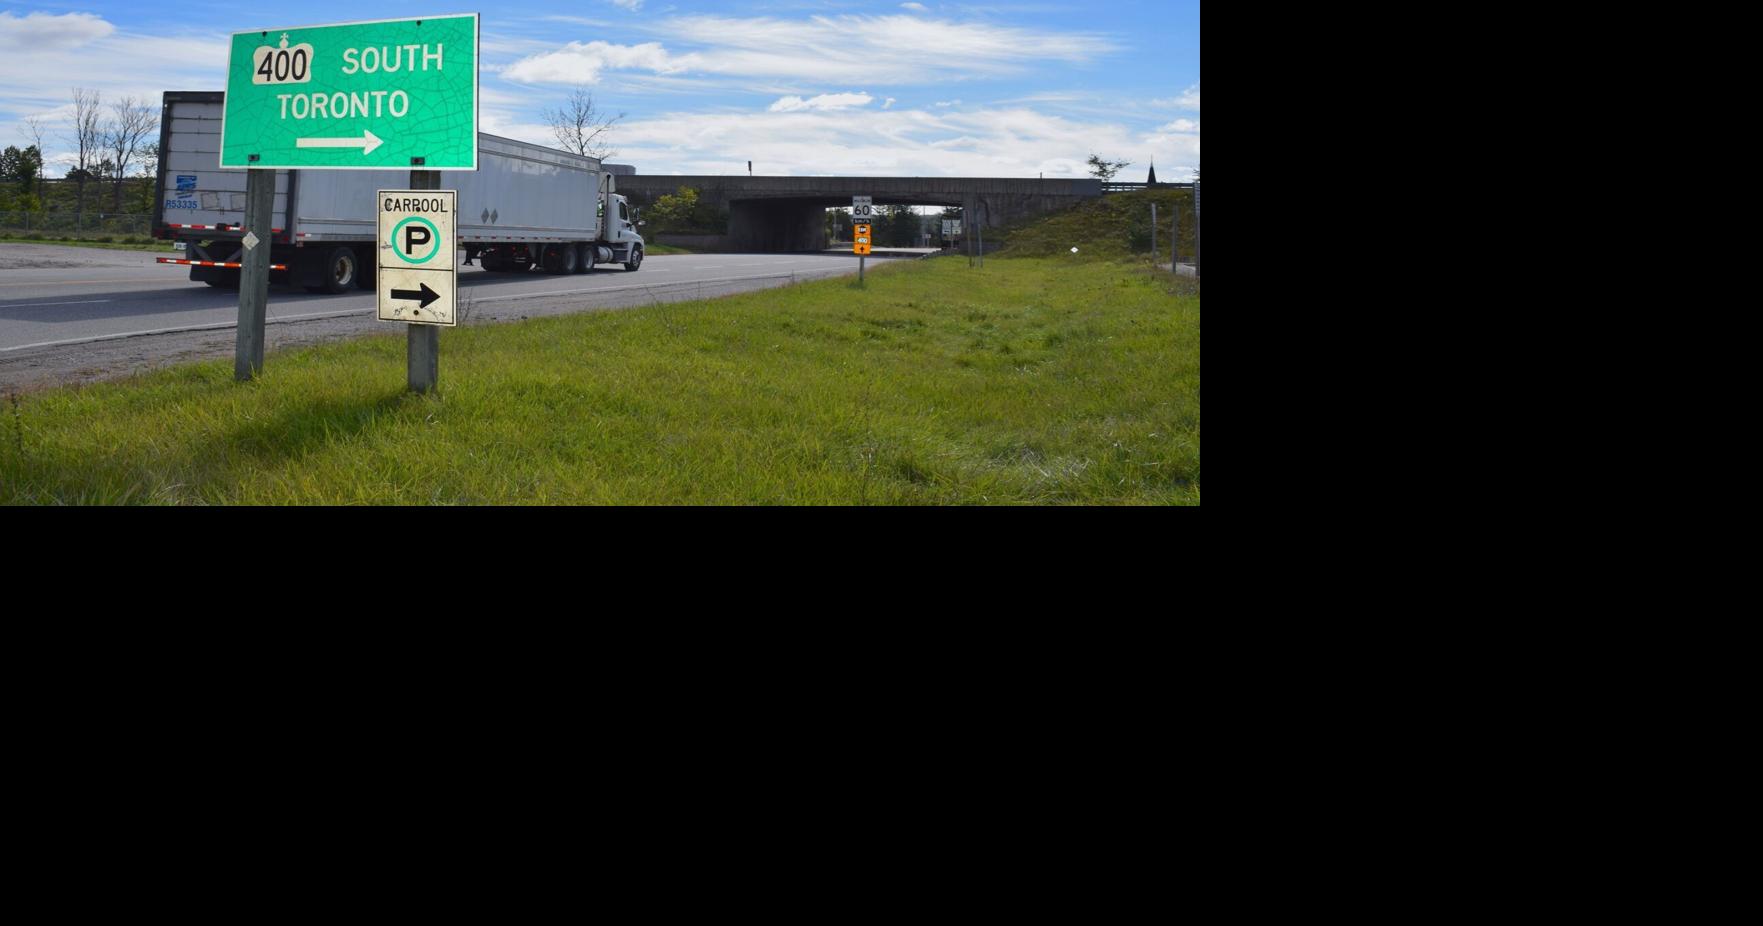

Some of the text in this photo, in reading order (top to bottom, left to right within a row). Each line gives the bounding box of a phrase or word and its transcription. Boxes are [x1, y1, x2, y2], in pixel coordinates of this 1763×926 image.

[257, 43, 443, 82] 400 SOUTH
[277, 90, 409, 120] TORONTO
[165, 200, 198, 209] R53335
[384, 198, 448, 213] CARPOOL
[854, 205, 870, 216] 60
[406, 226, 431, 255] P
